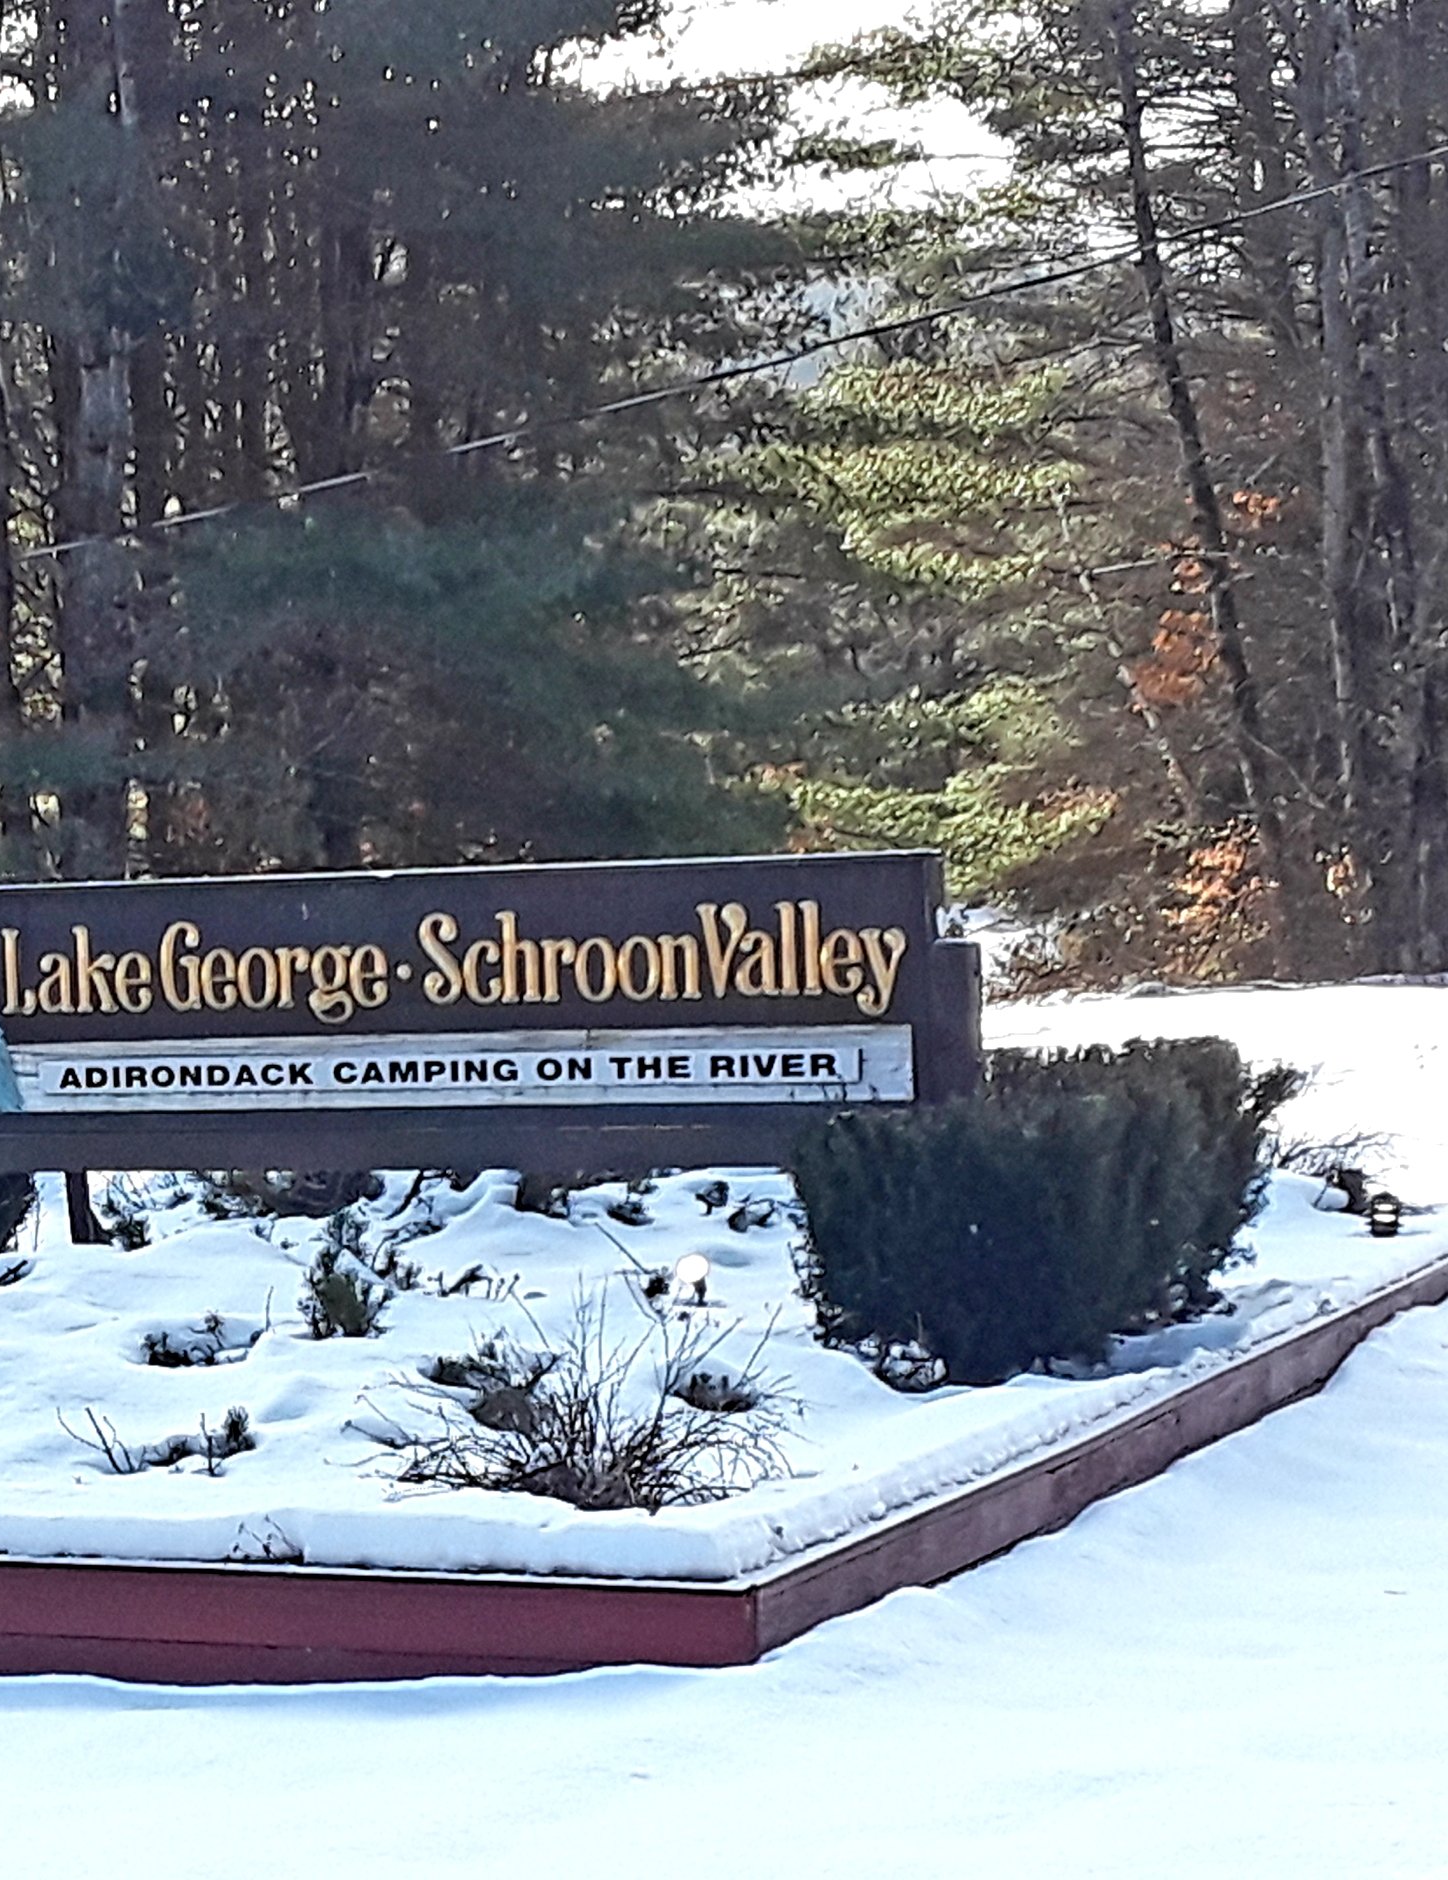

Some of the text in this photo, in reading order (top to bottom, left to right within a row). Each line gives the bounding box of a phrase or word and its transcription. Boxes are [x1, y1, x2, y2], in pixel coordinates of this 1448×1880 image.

[0, 899, 908, 1025] Lake George Schroon Valley
[59, 1053, 838, 1089] ADIRONDACK CAMPING ON THE RIVER
